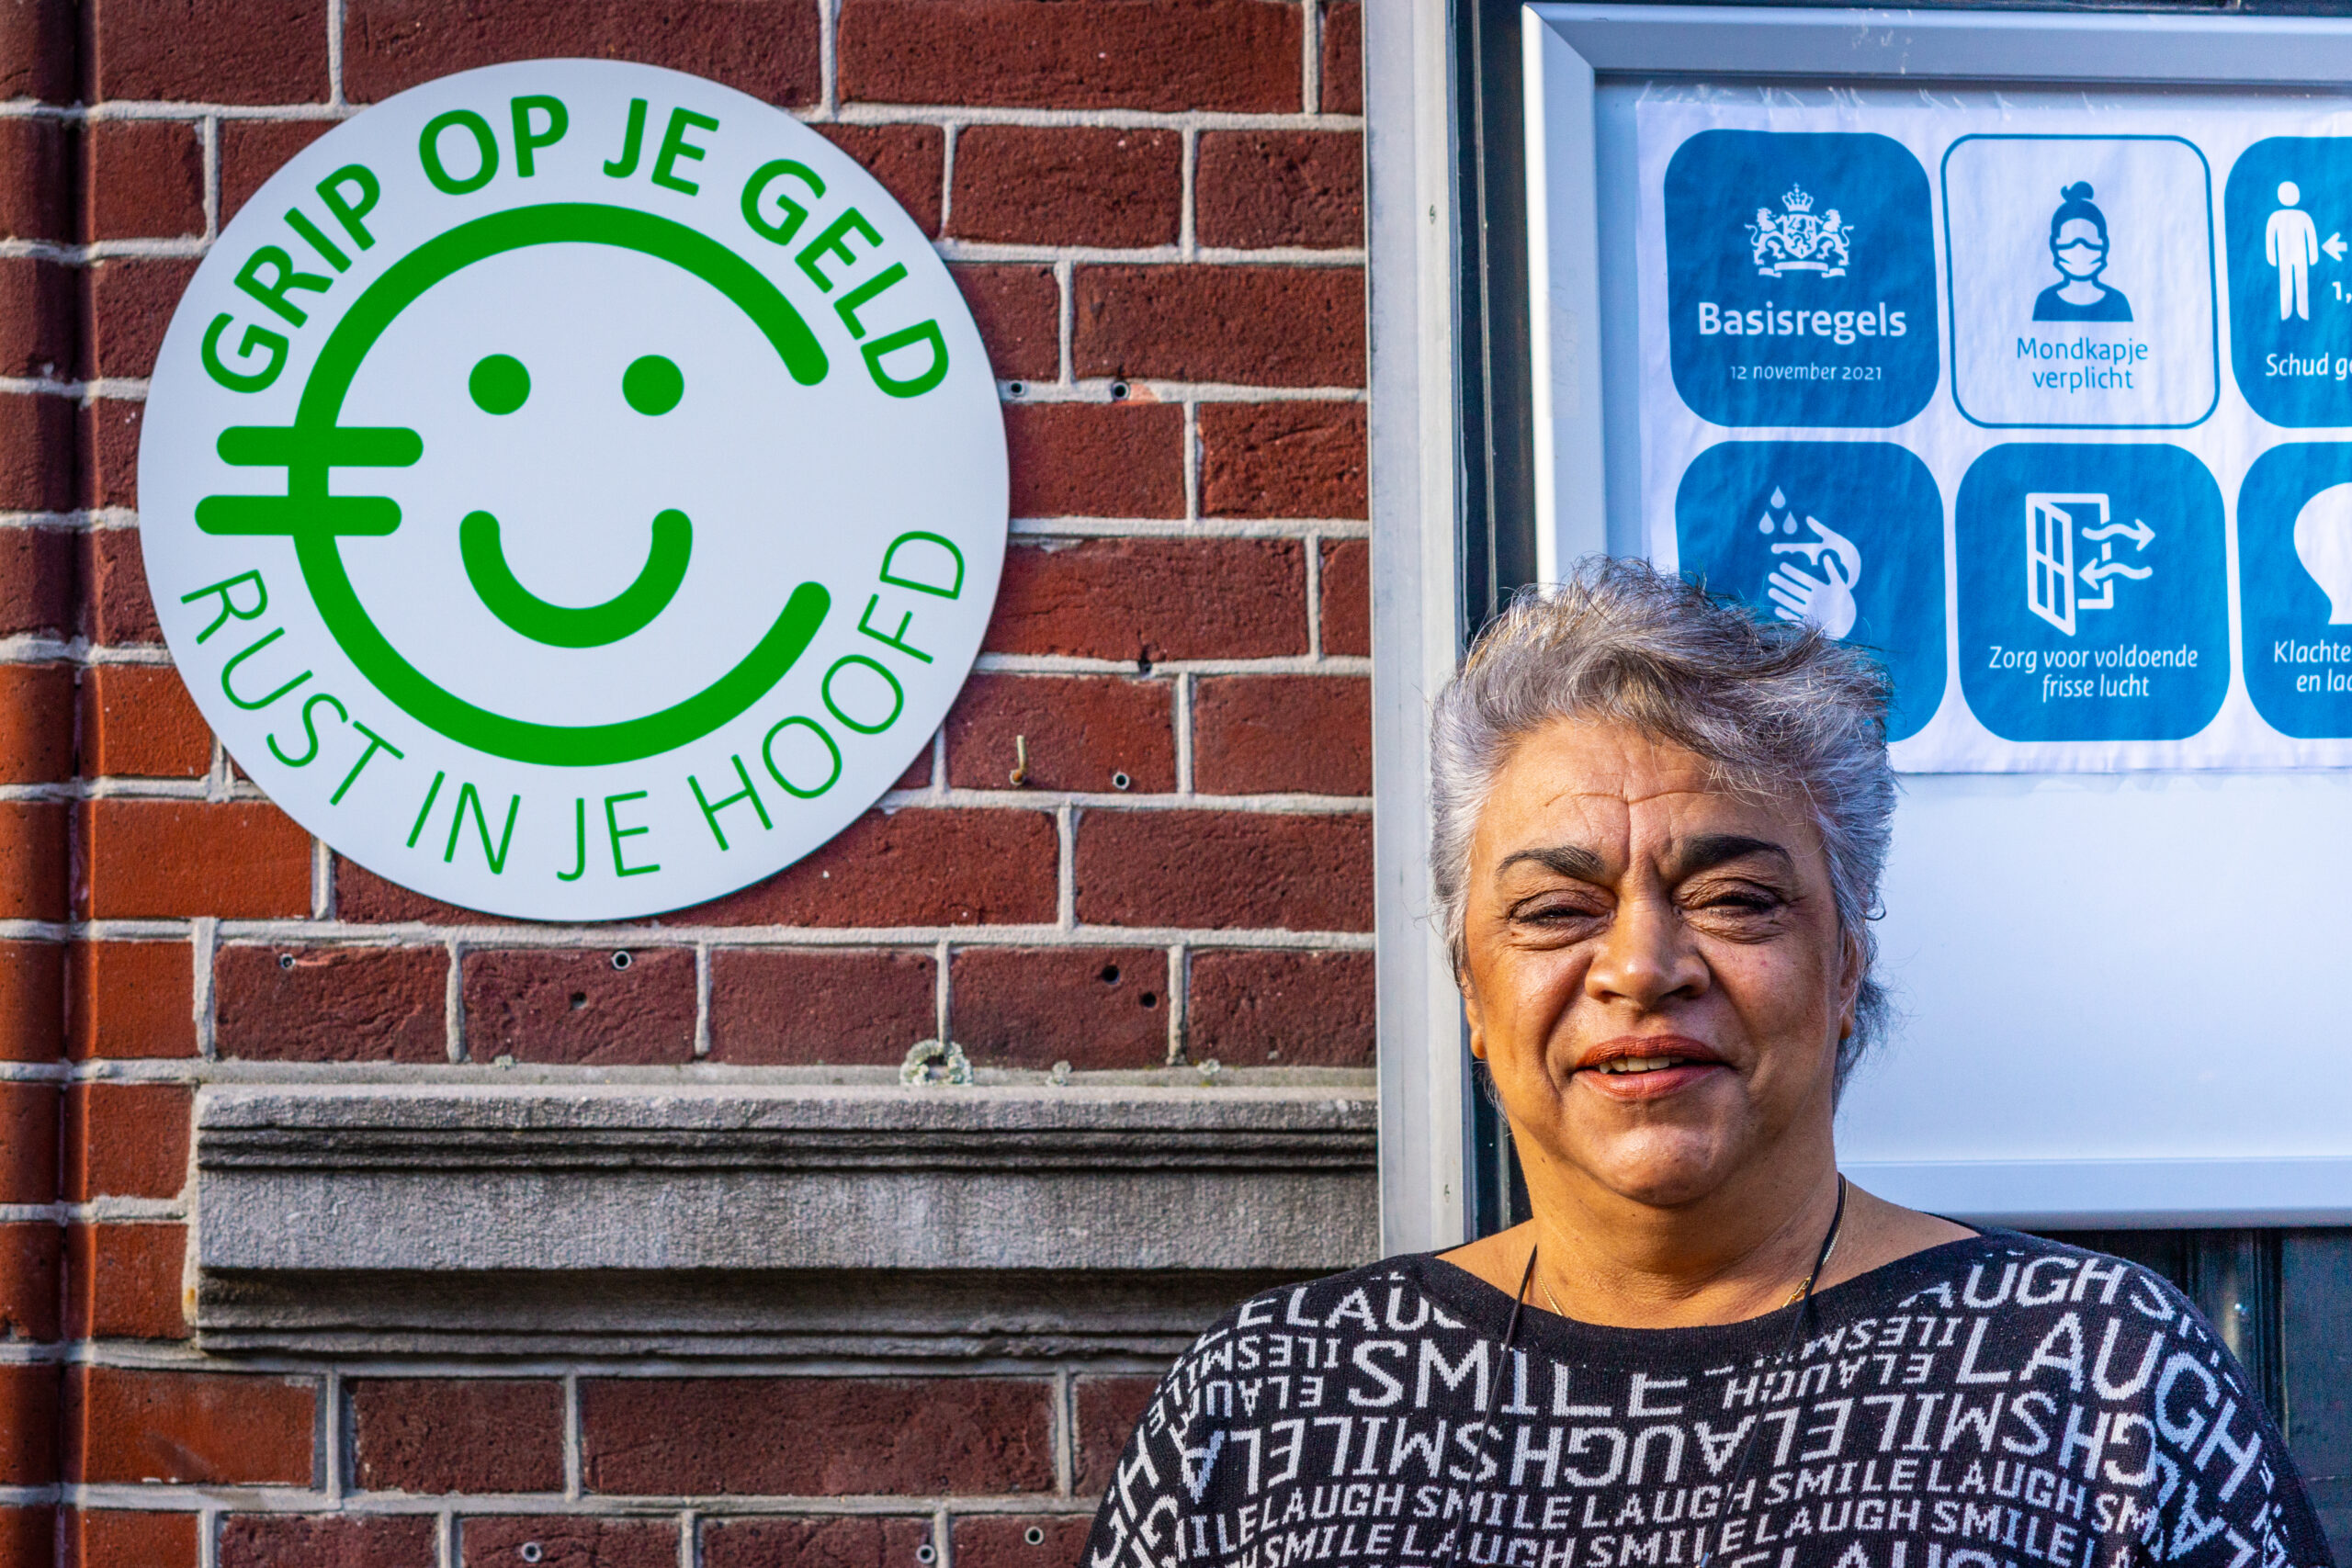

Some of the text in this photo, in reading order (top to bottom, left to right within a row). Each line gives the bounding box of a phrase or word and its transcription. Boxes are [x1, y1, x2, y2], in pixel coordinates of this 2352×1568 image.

[200, 95, 950, 399] GRIP OP JE GELD
[1698, 300, 1907, 345] Basisregels
[2017, 337, 2148, 365] Mondkapje
[2265, 352, 2329, 377] Schud
[1730, 362, 1882, 380] 12 november 2021
[2032, 366, 2134, 394] verplicht
[1988, 643, 2199, 674] Zorg voor voldoende
[2042, 672, 2150, 704] frisse lucht
[2296, 674, 2321, 692] en
[181, 530, 965, 882] RUST IN JE HOOFD
